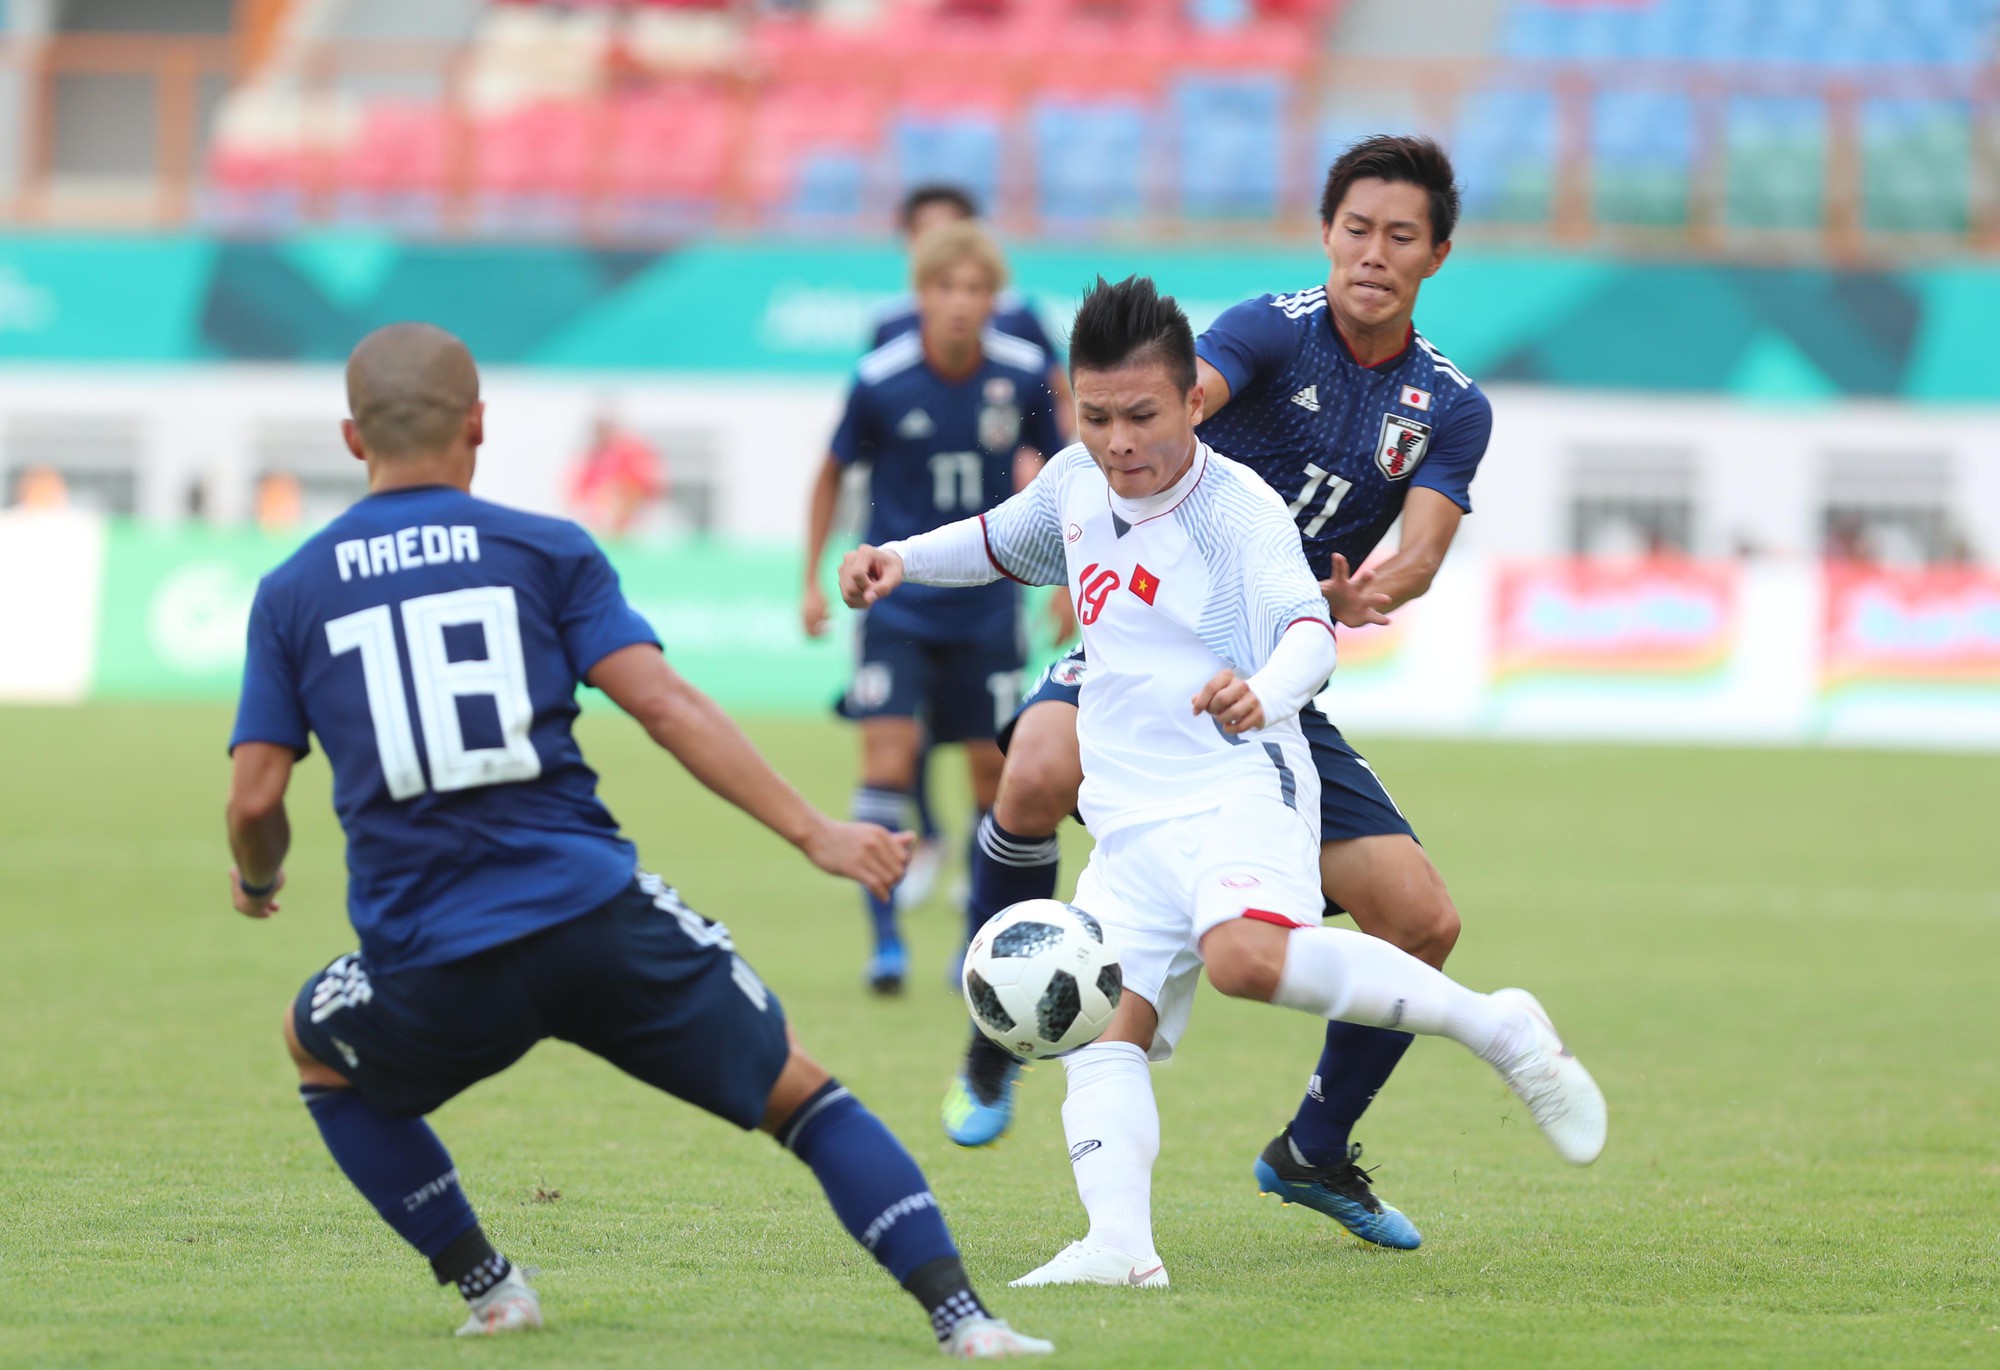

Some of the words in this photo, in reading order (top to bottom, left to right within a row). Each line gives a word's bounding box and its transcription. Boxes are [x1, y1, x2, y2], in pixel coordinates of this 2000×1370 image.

[335, 525, 480, 582] MAEDA
[1077, 562, 1120, 626] 19
[324, 585, 542, 802] 18
